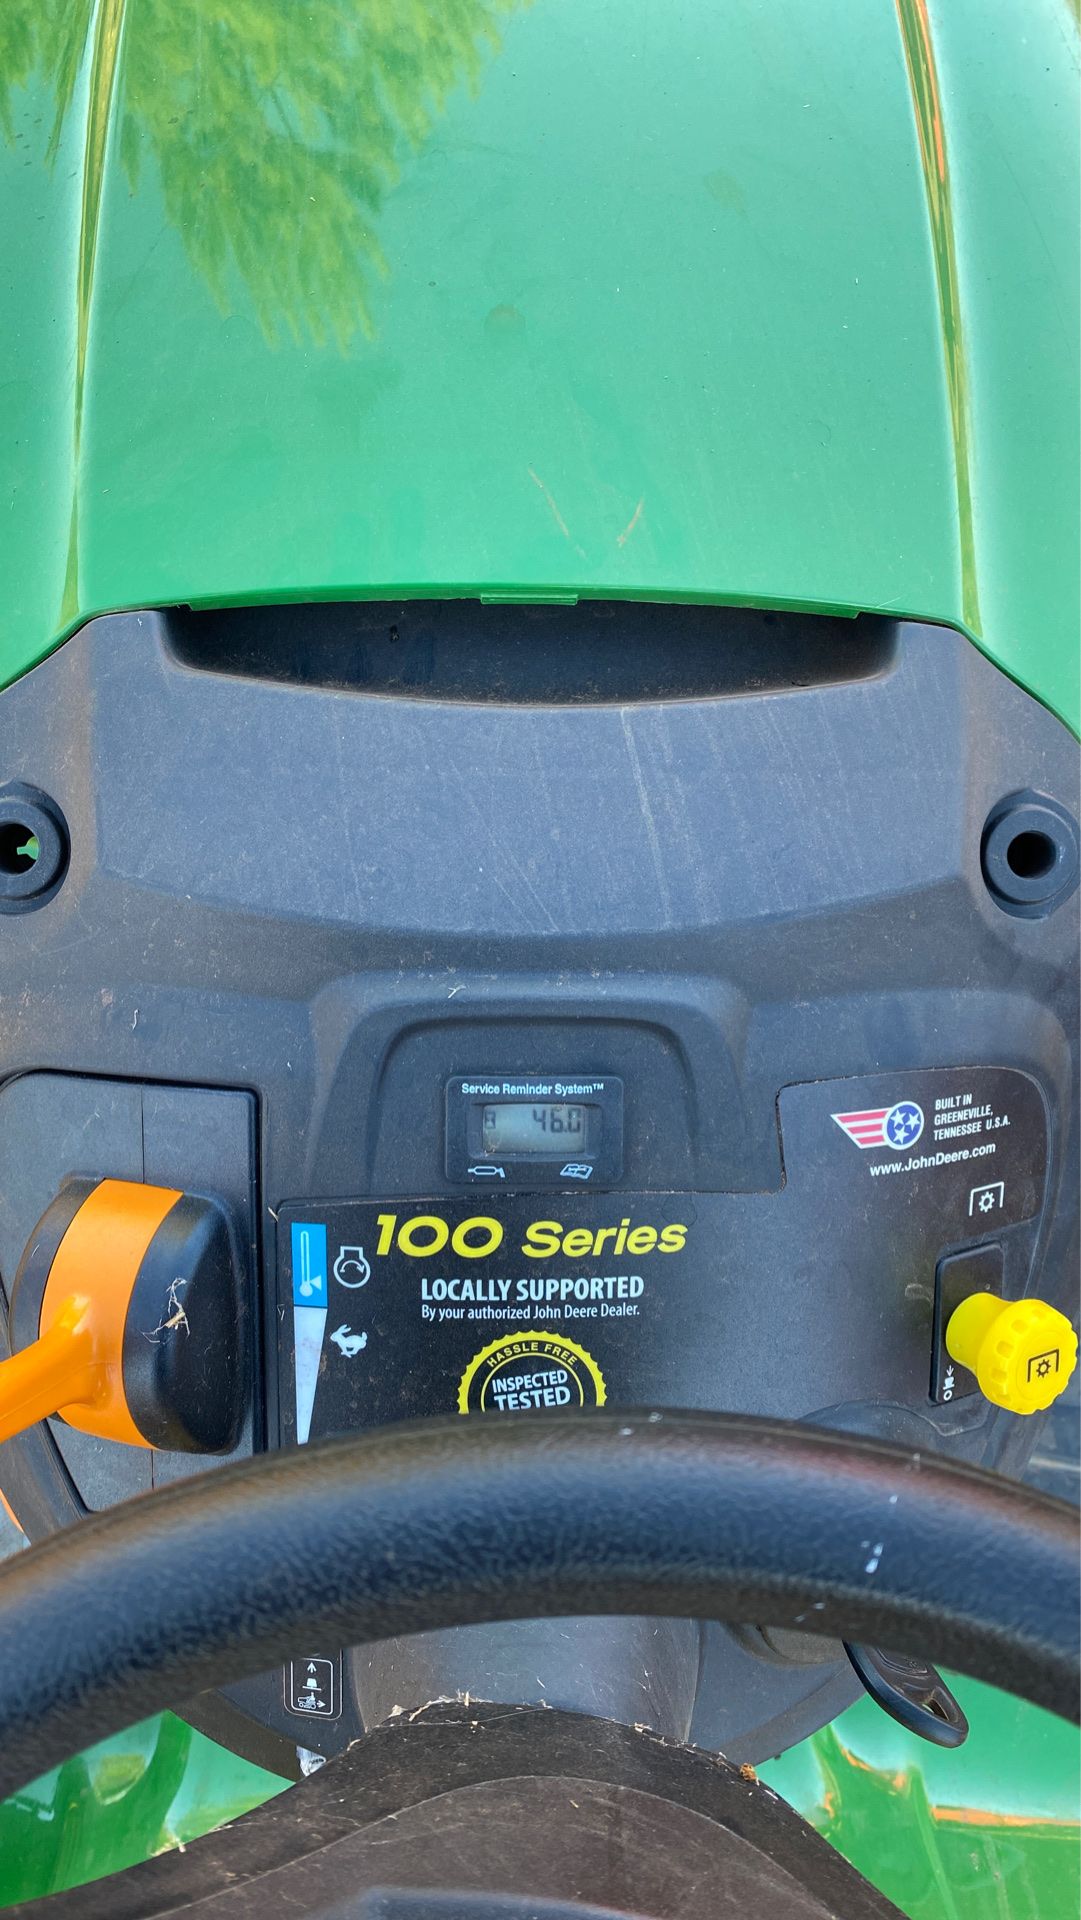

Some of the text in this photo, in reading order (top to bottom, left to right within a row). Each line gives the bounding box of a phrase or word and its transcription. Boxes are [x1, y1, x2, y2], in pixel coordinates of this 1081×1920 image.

[461, 1083, 500, 1095] Service
[502, 1083, 553, 1095] Reminder
[935, 1093, 973, 1110] BUILT IN
[934, 1104, 993, 1126] GREENEVILLE,
[934, 1115, 1011, 1141] TENNESSEE U.S.A.
[870, 1143, 996, 1177] www.JohnDeere.com
[376, 1214, 688, 1258] 100 Series
[421, 1276, 644, 1301] LOCALLY SUPPORTED
[421, 1302, 640, 1322] By your authorized John Deere Dealer.
[486, 1342, 578, 1367] HASSLE FREE
[492, 1369, 568, 1393] INSPECTED
[494, 1386, 571, 1411] TESTED
